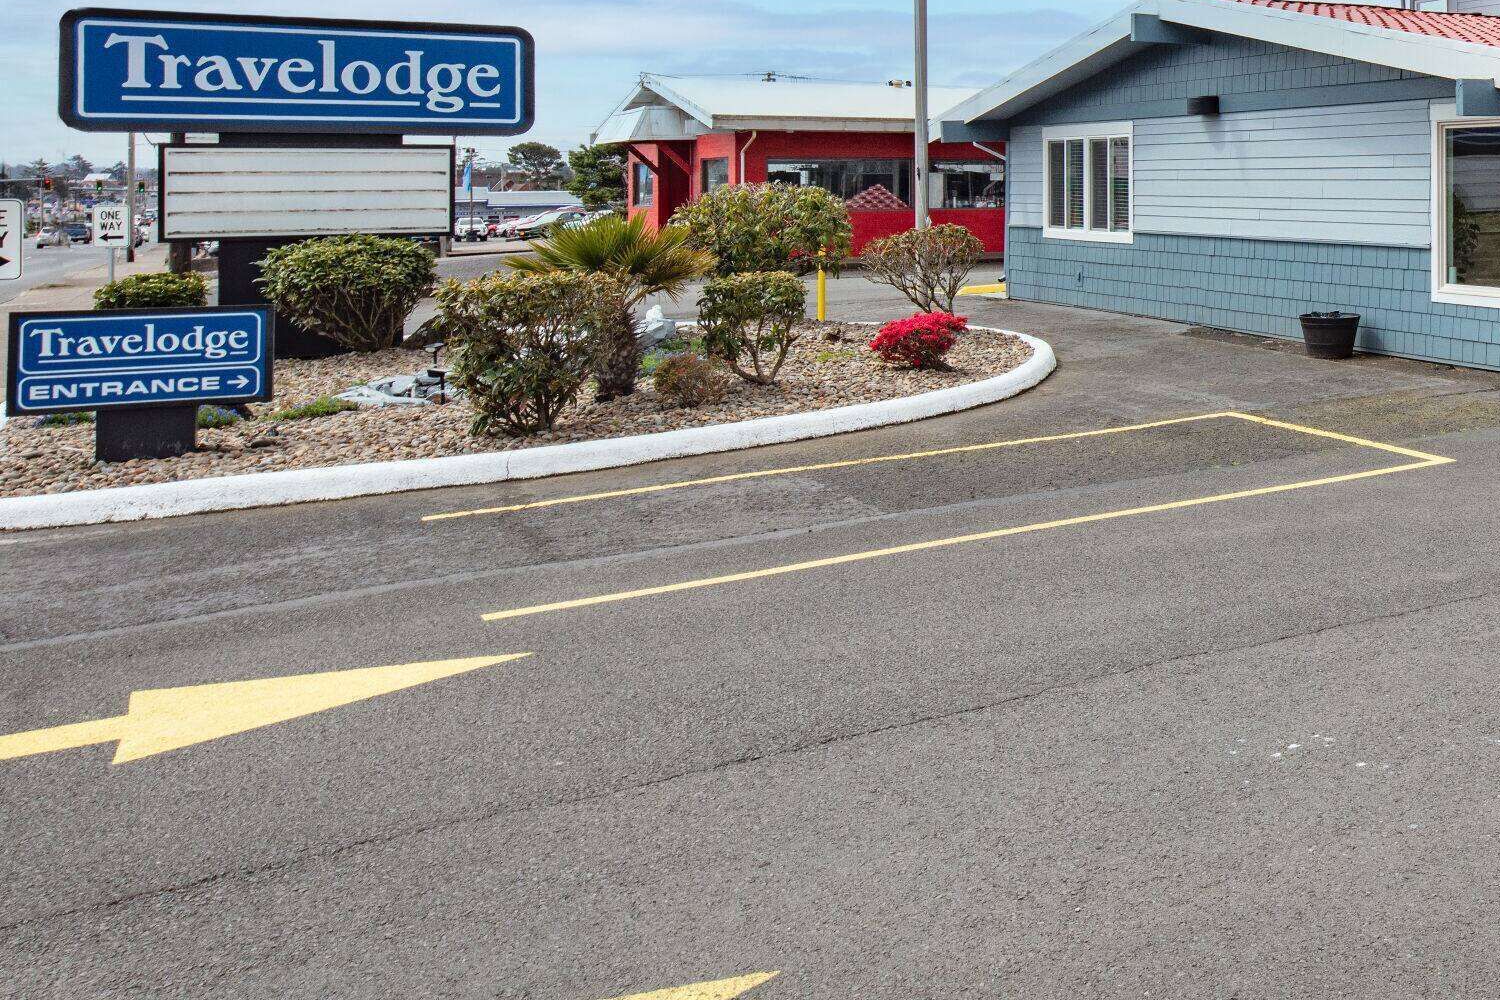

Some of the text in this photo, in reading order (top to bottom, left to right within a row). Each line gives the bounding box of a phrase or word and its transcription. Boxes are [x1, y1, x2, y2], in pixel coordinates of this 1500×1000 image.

[104, 32, 501, 113] Travelodge
[100, 210, 121, 221] ONE
[100, 221, 122, 231] WAY
[29, 323, 249, 360] Travelodge
[28, 376, 221, 400] ENTRANCE
